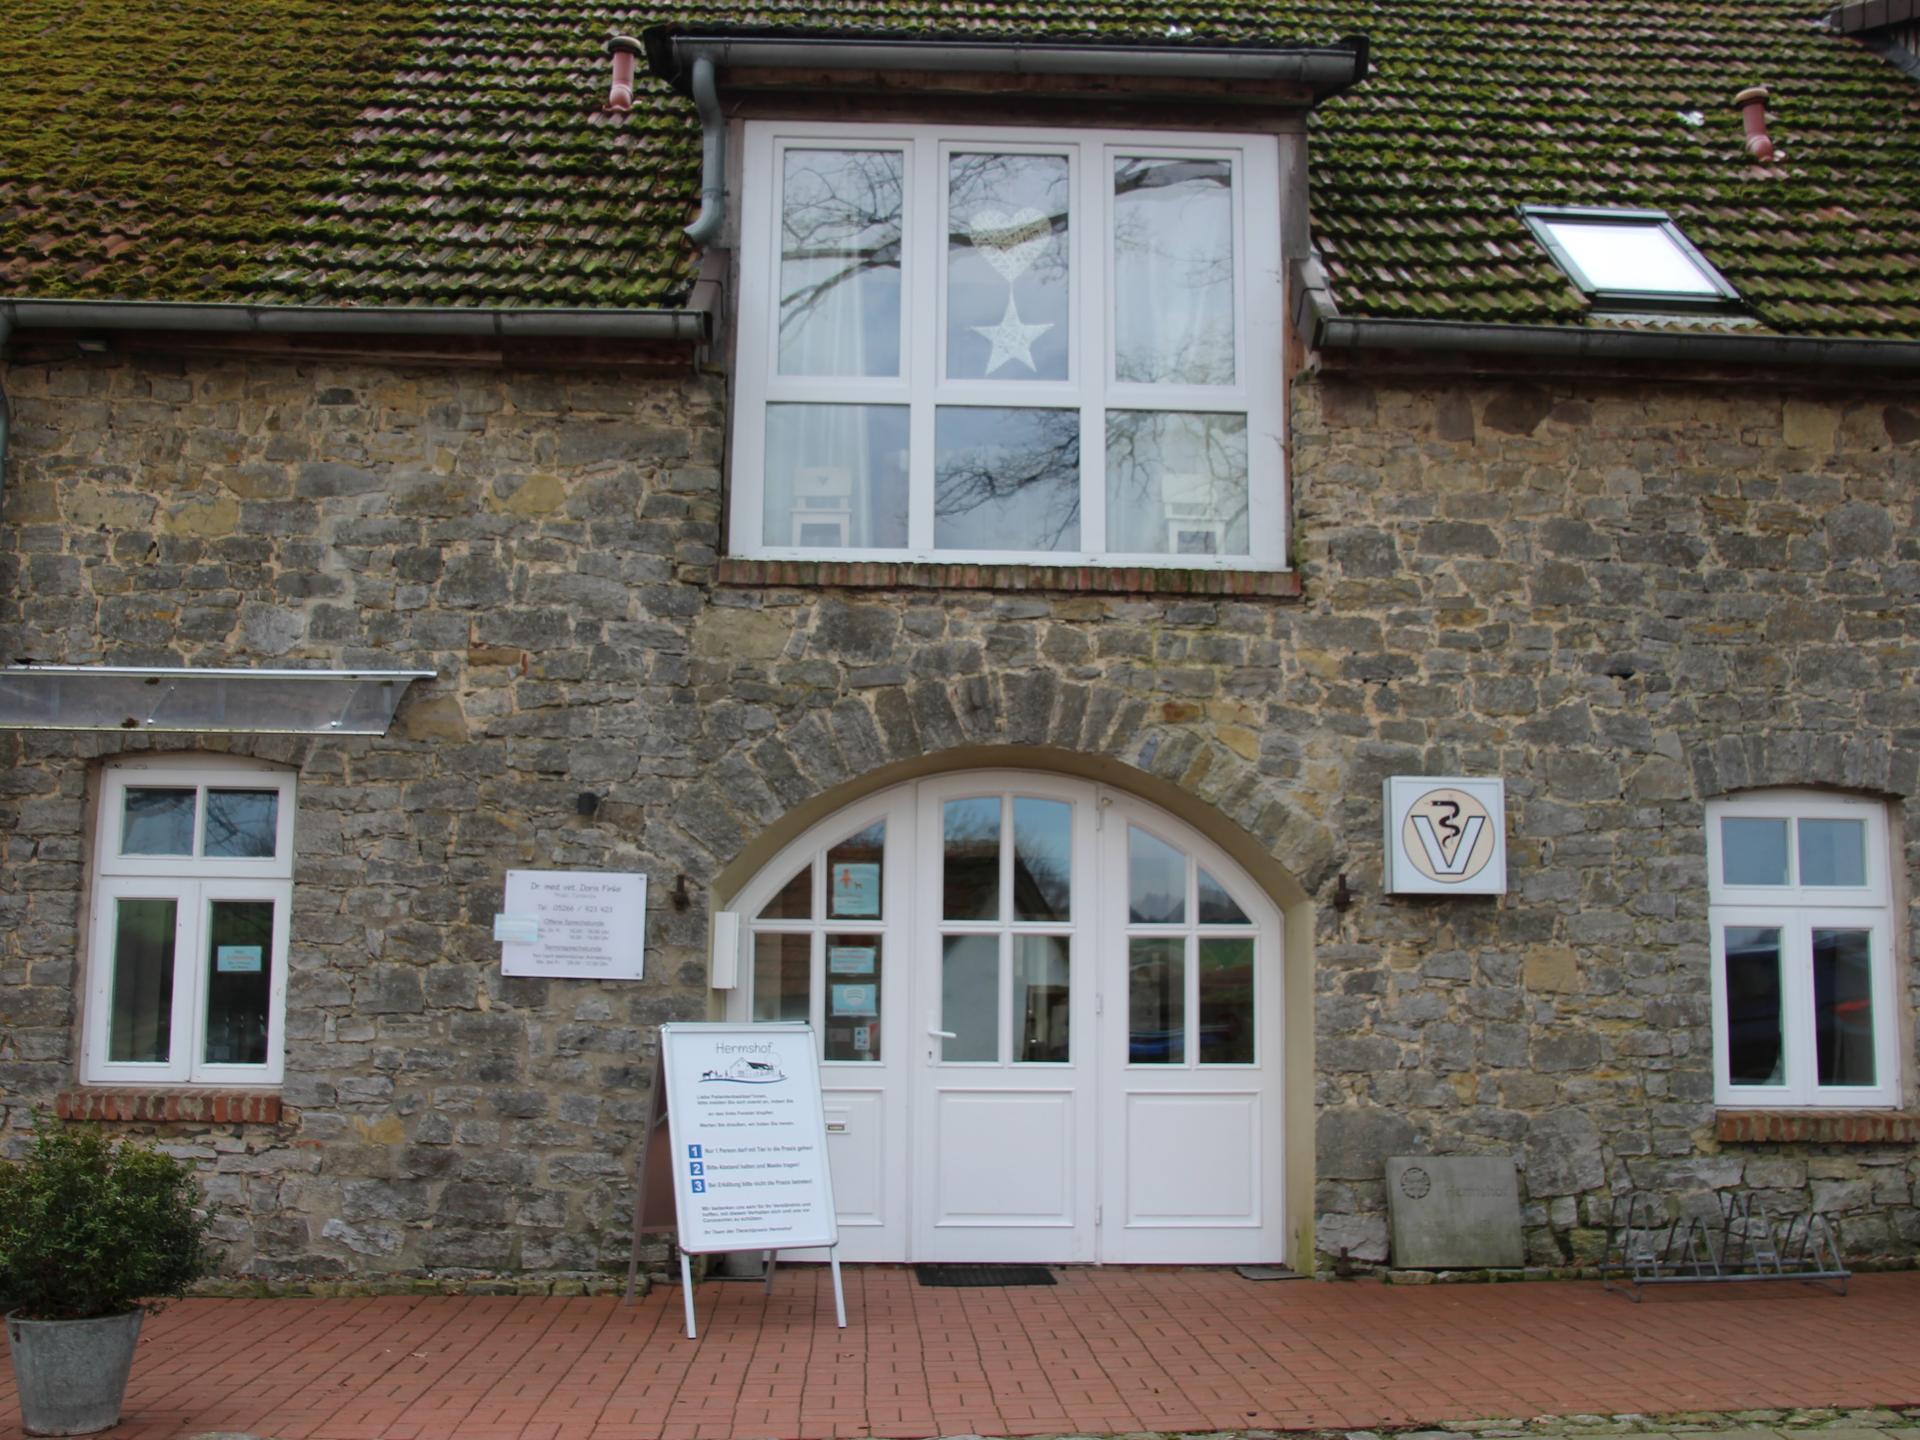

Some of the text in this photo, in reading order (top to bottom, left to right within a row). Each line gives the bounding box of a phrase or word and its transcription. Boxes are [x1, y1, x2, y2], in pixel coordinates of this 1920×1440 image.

[716, 1042, 773, 1054] Hermshof
[693, 1163, 701, 1174] 2
[694, 1181, 703, 1192] 3
